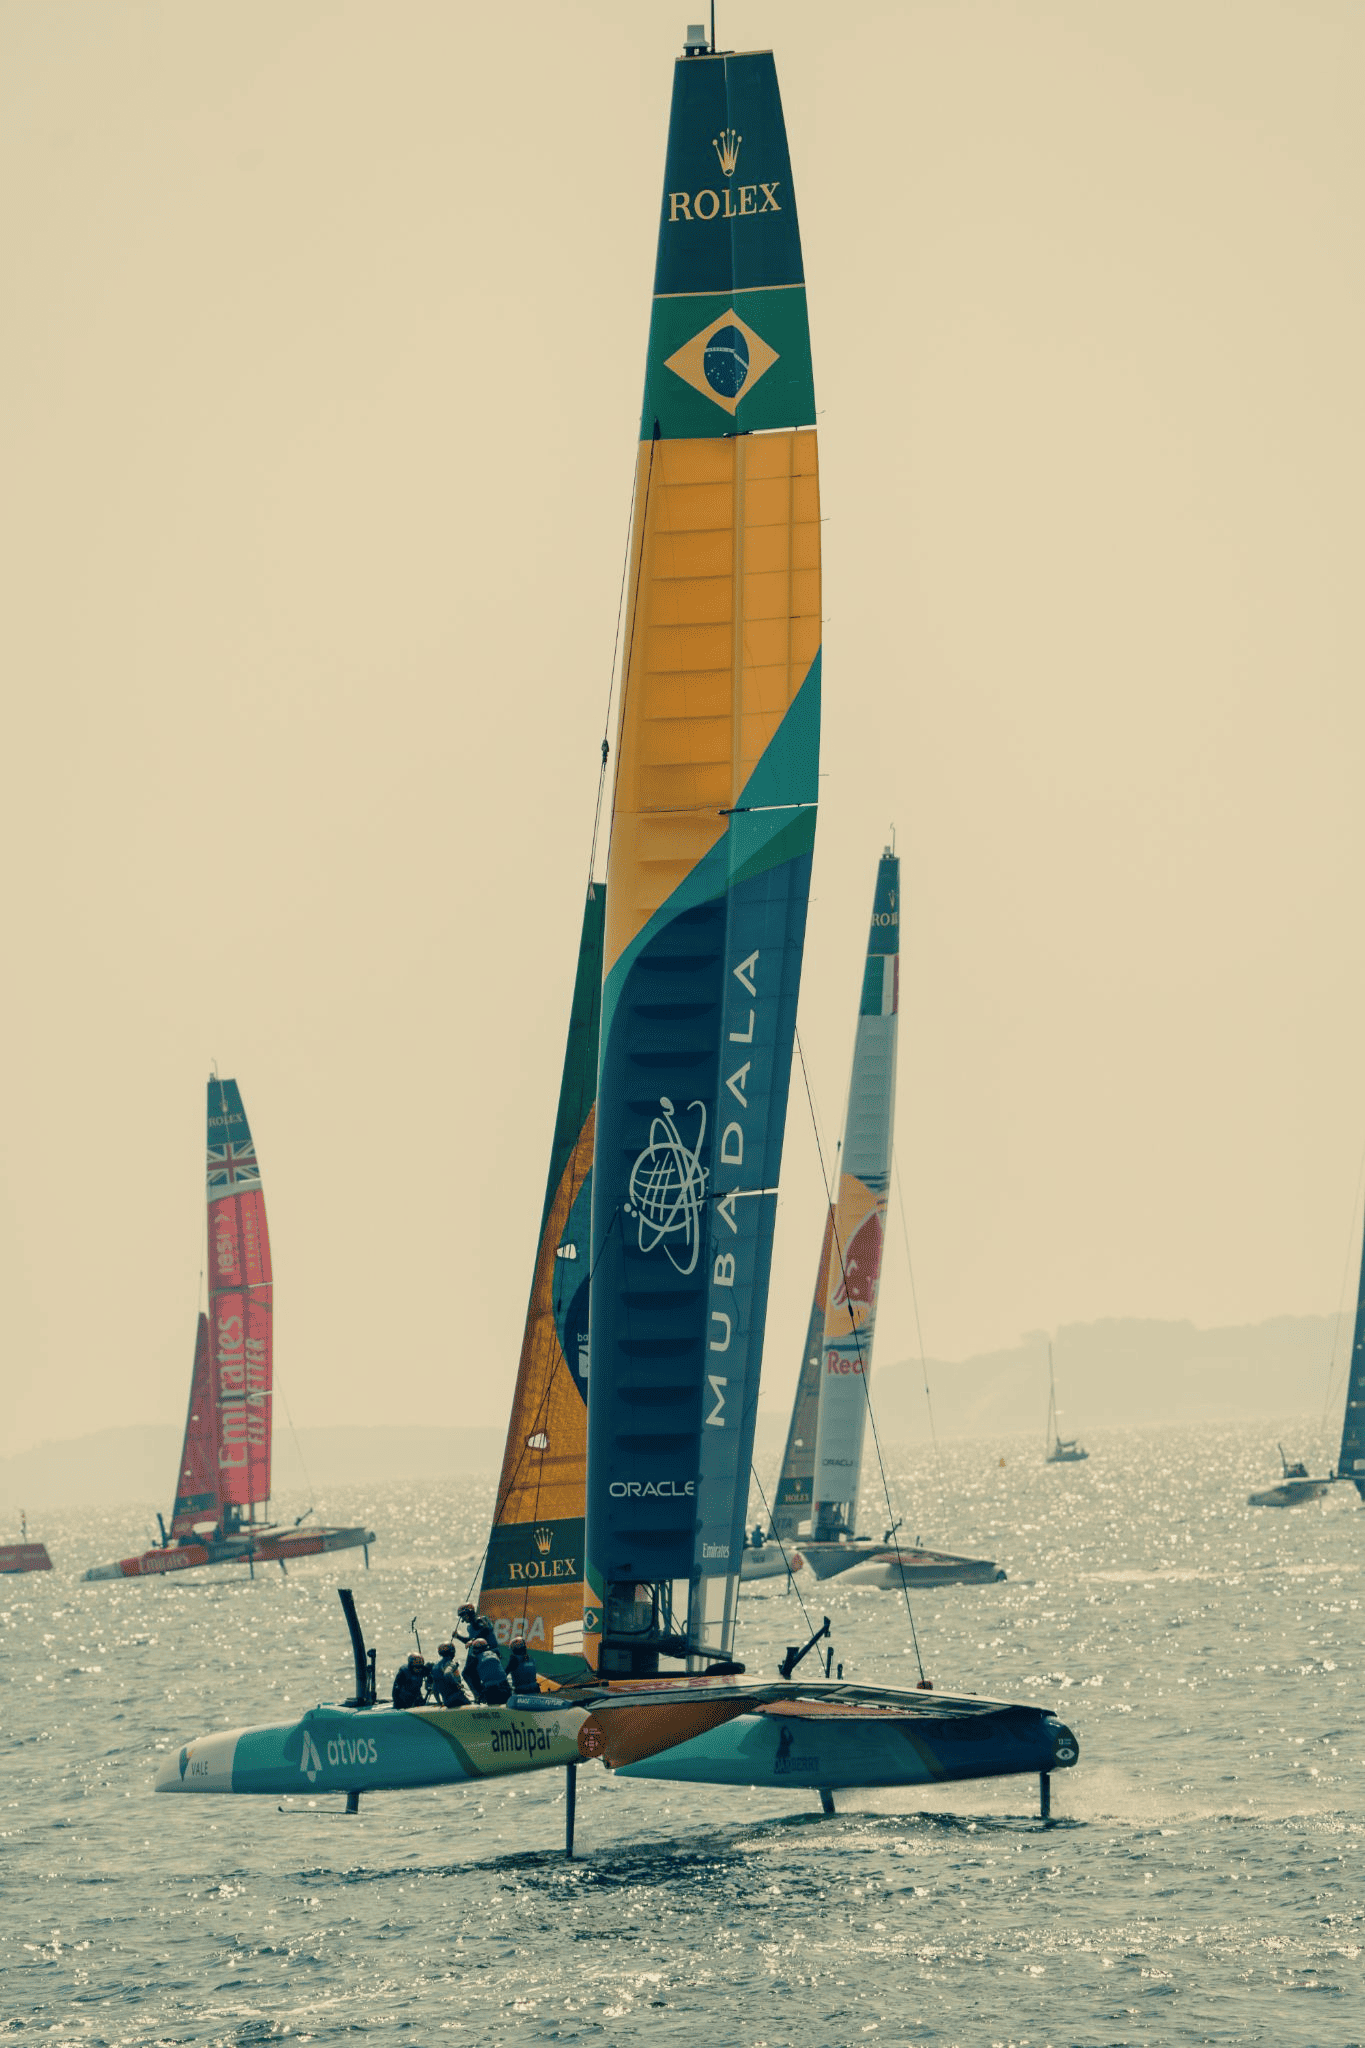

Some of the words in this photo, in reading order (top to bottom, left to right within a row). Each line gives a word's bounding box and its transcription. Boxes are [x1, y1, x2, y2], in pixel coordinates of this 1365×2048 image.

[668, 181, 782, 222] ROLEX
[208, 1113, 243, 1127] ROLEX
[705, 949, 760, 1428] MUBADALA
[216, 1314, 248, 1469] Emirates
[247, 1411, 265, 1446] FLY
[608, 1480, 695, 1498] ORACLE
[702, 1542, 730, 1559] Emirates
[507, 1557, 577, 1580] ROLEX
[494, 1615, 545, 1646] BRA
[327, 1733, 378, 1766] atvos
[490, 1721, 553, 1758] ambipar
[191, 1760, 209, 1776] VALE
